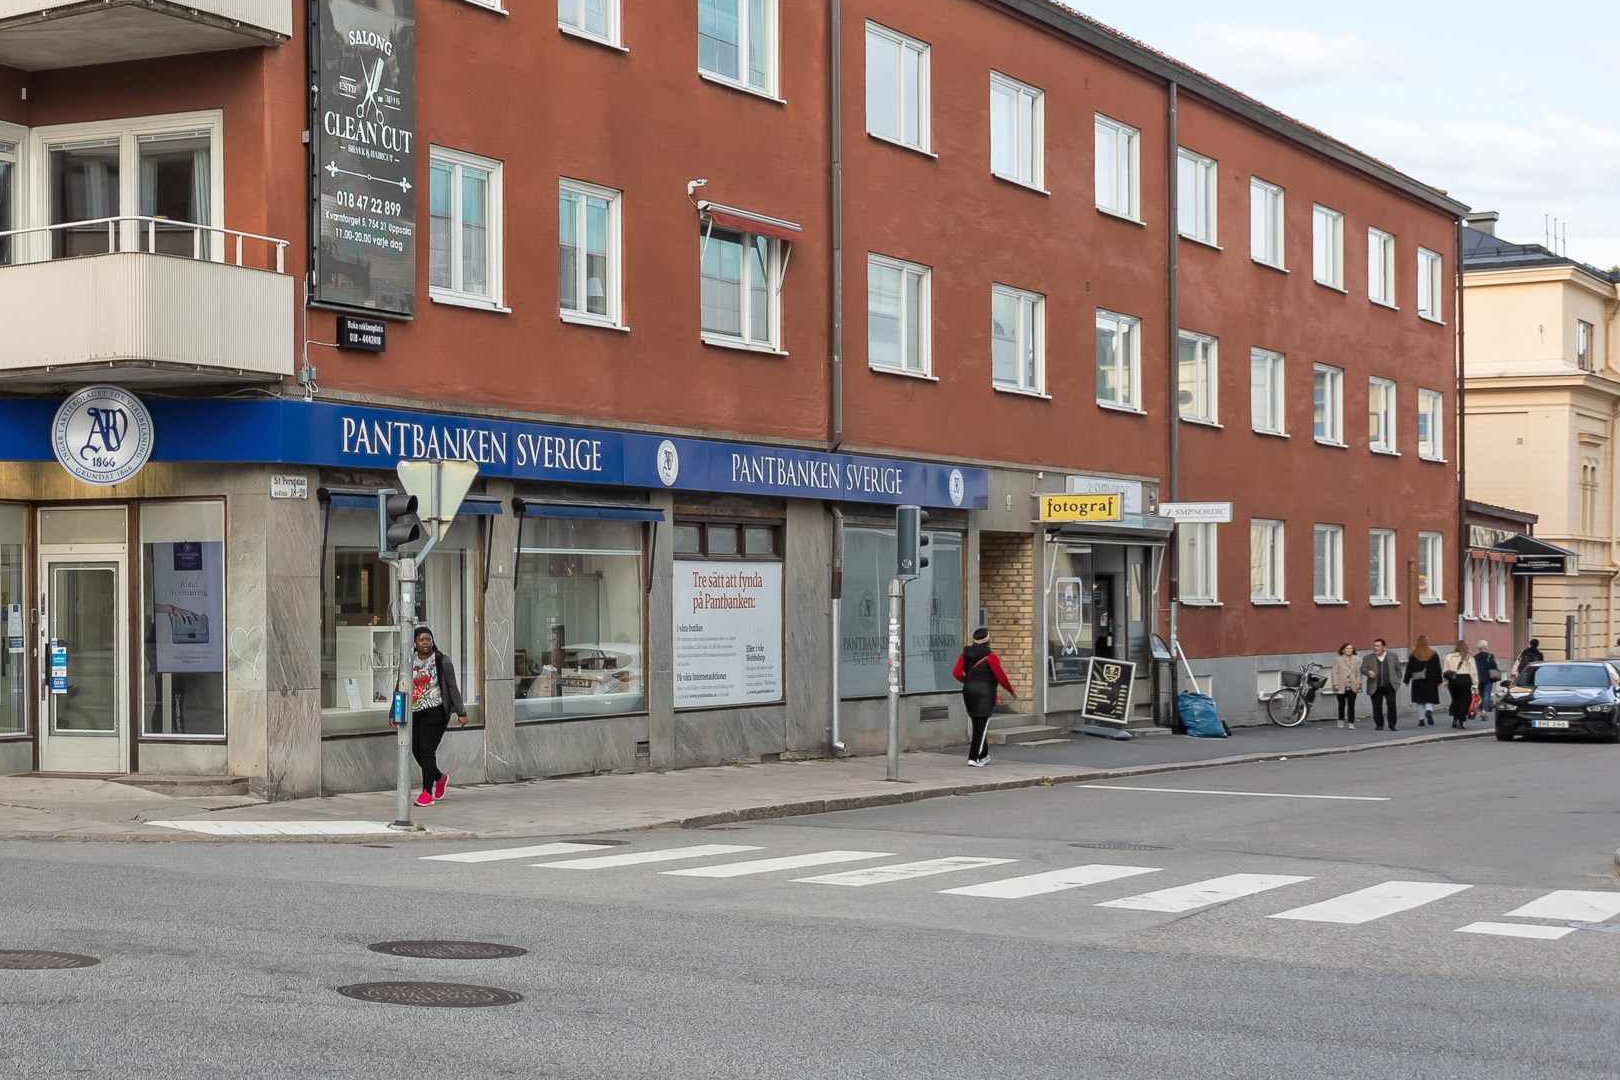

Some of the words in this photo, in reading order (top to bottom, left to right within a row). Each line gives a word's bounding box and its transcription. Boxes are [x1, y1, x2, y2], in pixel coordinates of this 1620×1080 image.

[349, 30, 392, 56] SALONG
[340, 81, 356, 93] ESTD
[324, 111, 377, 145] CLEAN
[381, 125, 412, 153] CUT
[336, 190, 354, 208] 018
[357, 195, 368, 210] 47
[371, 199, 382, 214] 22
[385, 201, 401, 216] 899
[325, 210, 361, 226] Kvarntorget
[368, 219, 378, 229] 754
[380, 221, 387, 231] 21
[389, 223, 412, 236] Uppsala
[335, 228, 372, 244] 11.00-20.00
[372, 235, 389, 248] varje
[390, 238, 402, 252] dag
[341, 417, 507, 464] PANTBANKEN
[516, 433, 602, 471] SVERIGE
[75, 467, 114, 480] GRUNDAT
[116, 466, 133, 477] 1866
[92, 457, 116, 468] 1866
[731, 453, 840, 490] PANTBANKEN
[846, 464, 903, 494] SVERIGE
[1047, 497, 1113, 517] fotograf
[693, 571, 706, 588] Tre
[708, 572, 725, 588] sätt
[725, 573, 737, 588] att
[739, 571, 763, 592] fynda
[693, 591, 702, 614] på
[705, 593, 756, 610] Pantbanken:
